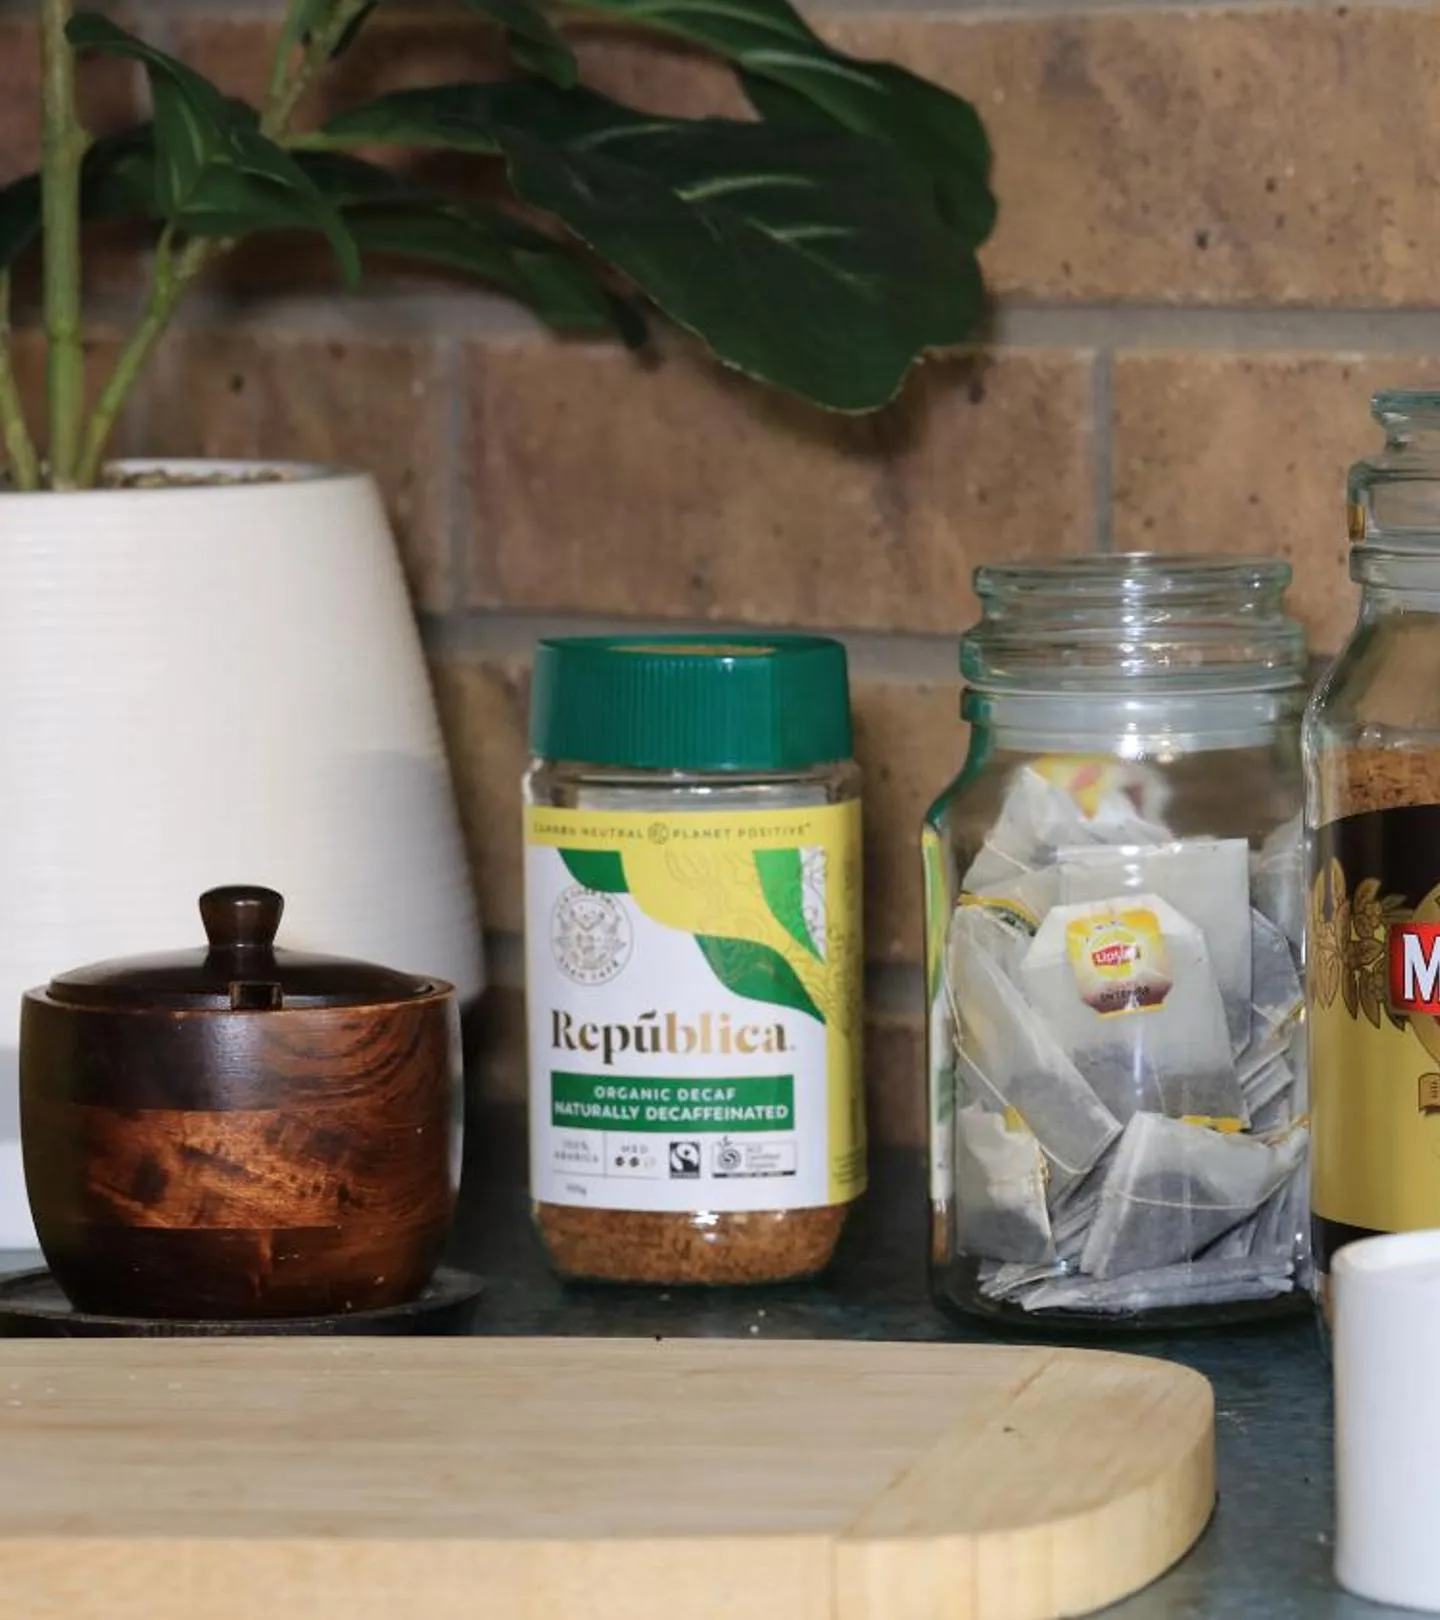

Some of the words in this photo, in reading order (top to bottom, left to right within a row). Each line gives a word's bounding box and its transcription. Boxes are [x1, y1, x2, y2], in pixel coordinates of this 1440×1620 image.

[672, 828, 731, 839] PLANET
[551, 1009, 788, 1065] República
[593, 1085, 670, 1102] ORGANIC
[677, 1085, 736, 1102] DECAF
[553, 1101, 639, 1121] NATURALLY
[645, 1103, 789, 1122] DECAFFEINATED
